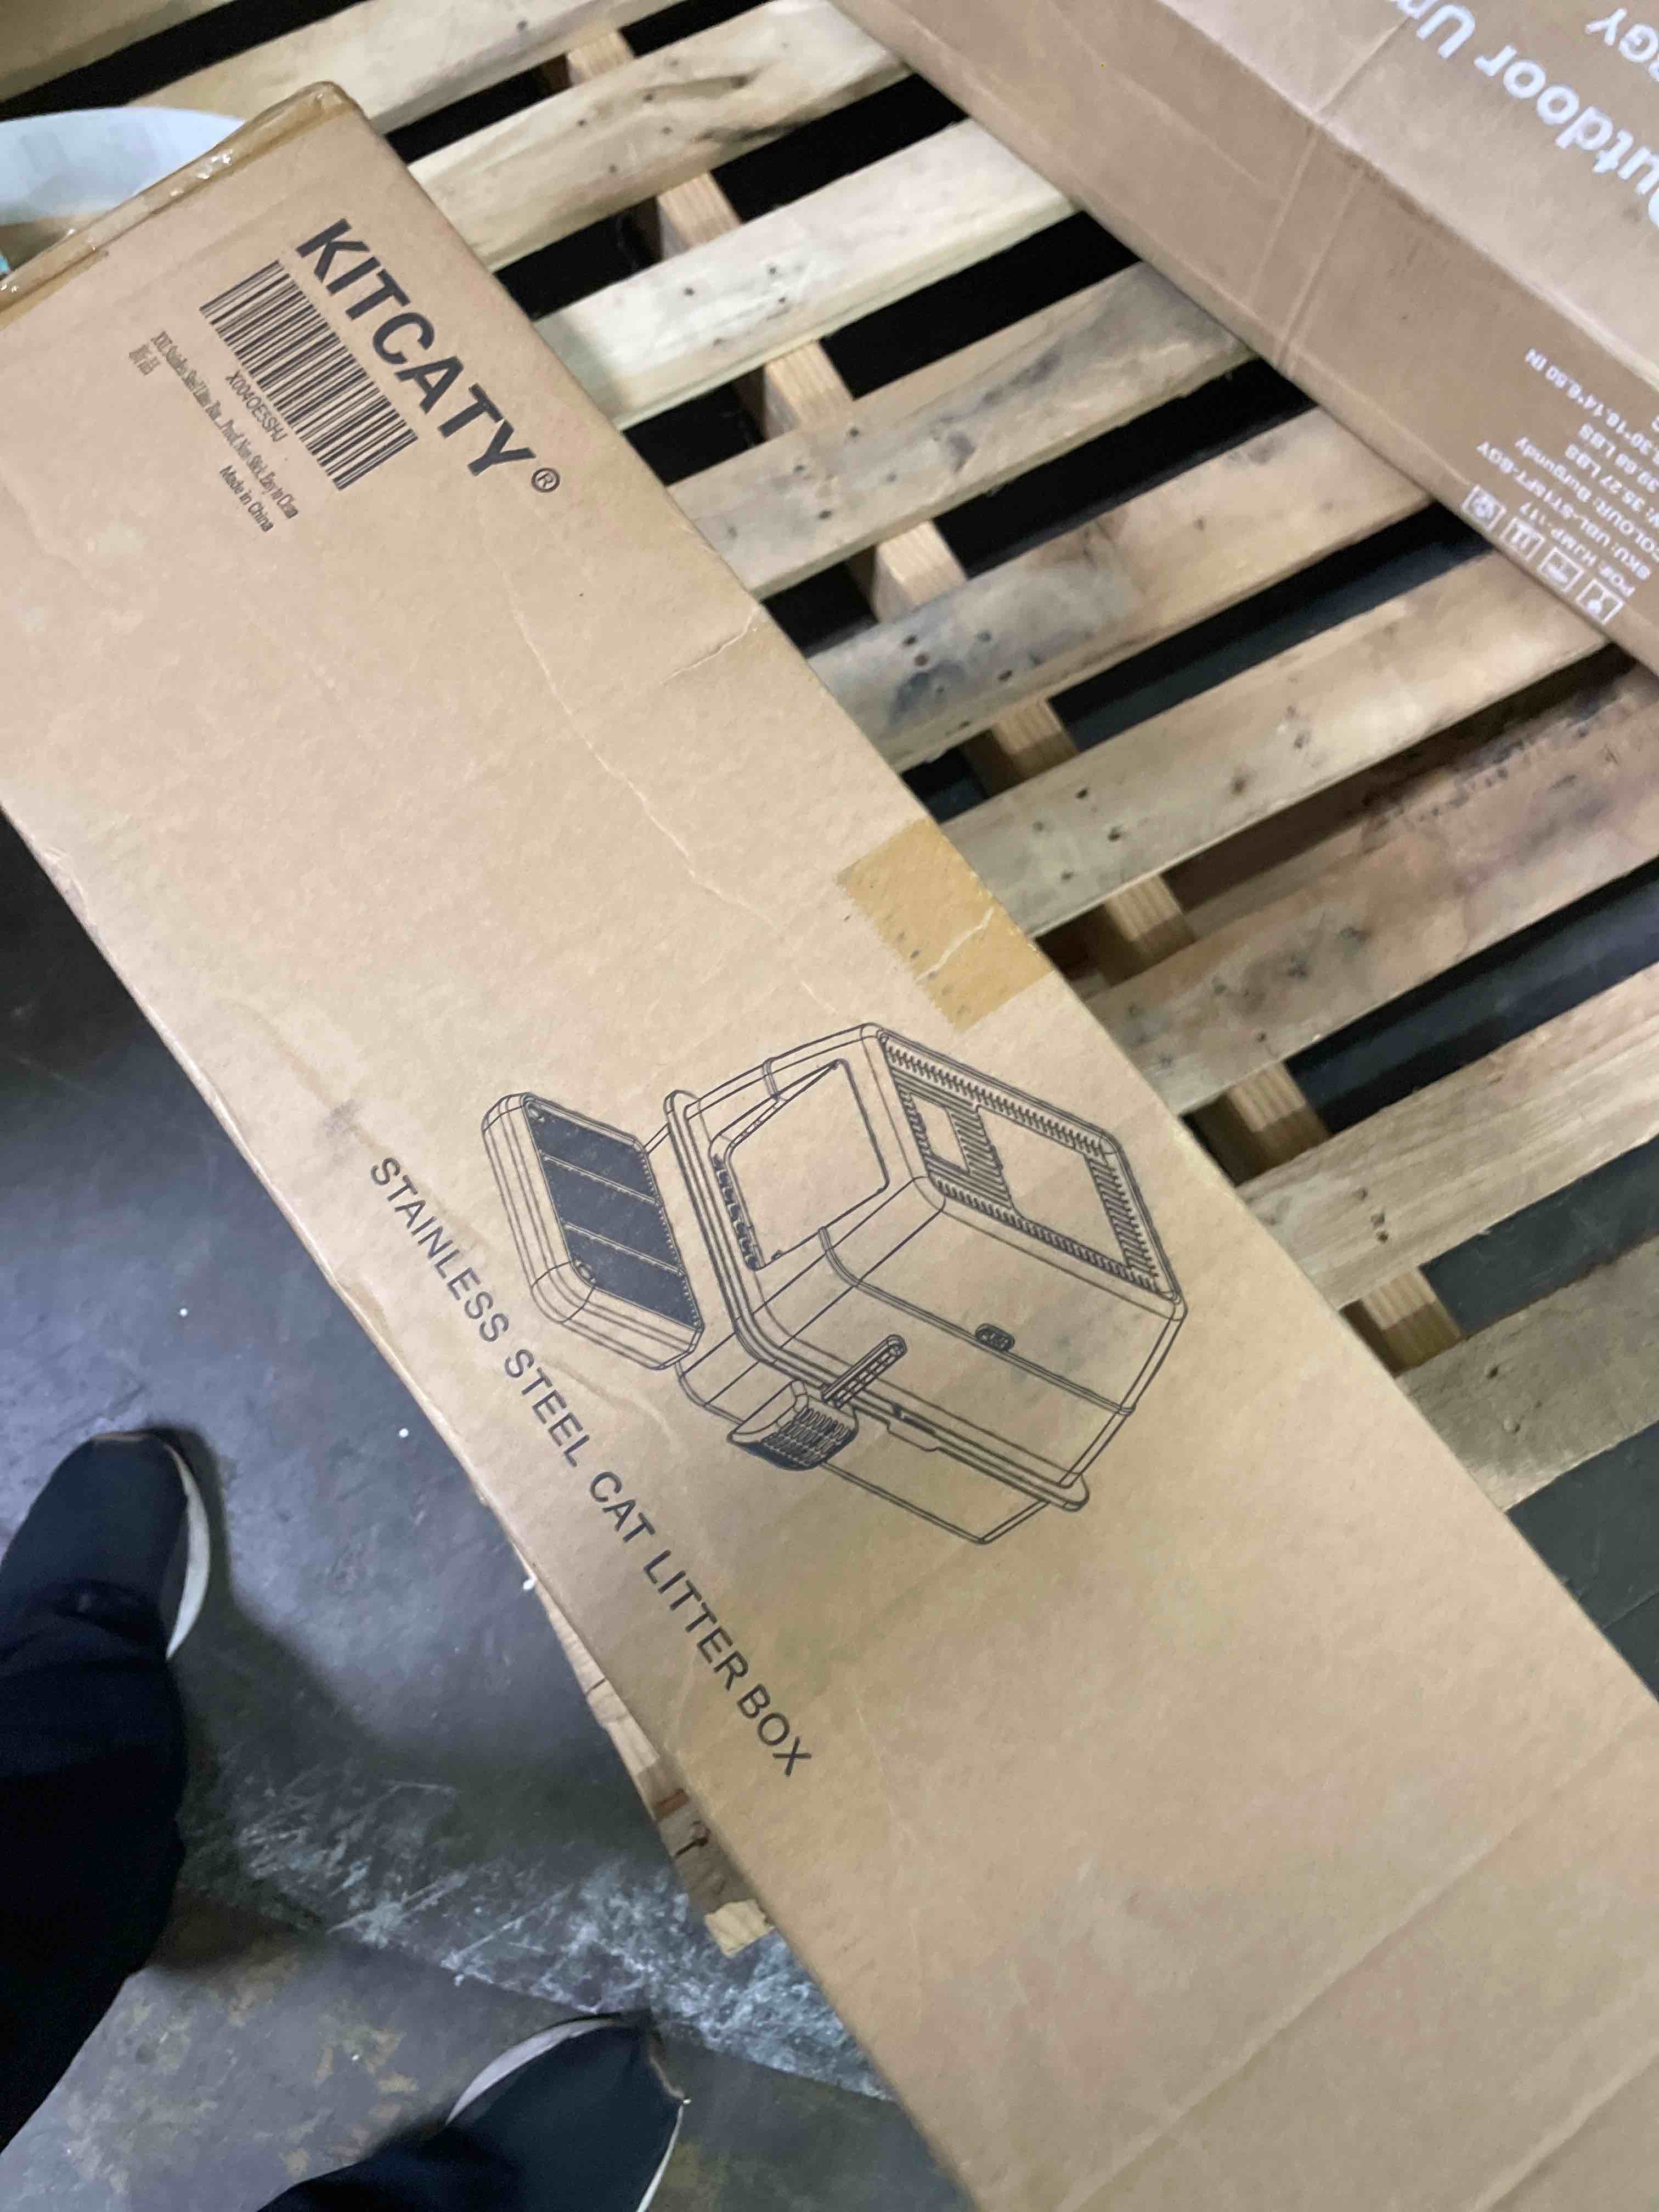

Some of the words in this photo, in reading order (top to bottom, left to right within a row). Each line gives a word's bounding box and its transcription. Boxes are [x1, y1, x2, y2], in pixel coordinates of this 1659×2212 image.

[295, 218, 537, 477] KITCATY
[219, 465, 245, 494] Made
[239, 489, 252, 505] in
[247, 501, 274, 532] China
[1514, 436, 1592, 503] Burgundy
[370, 1156, 510, 1343] STAINLESS
[504, 1348, 592, 1469] STEEL
[589, 1471, 657, 1544] CAT
[642, 1549, 749, 1691] LITTER
[736, 1683, 812, 1778] BOX
